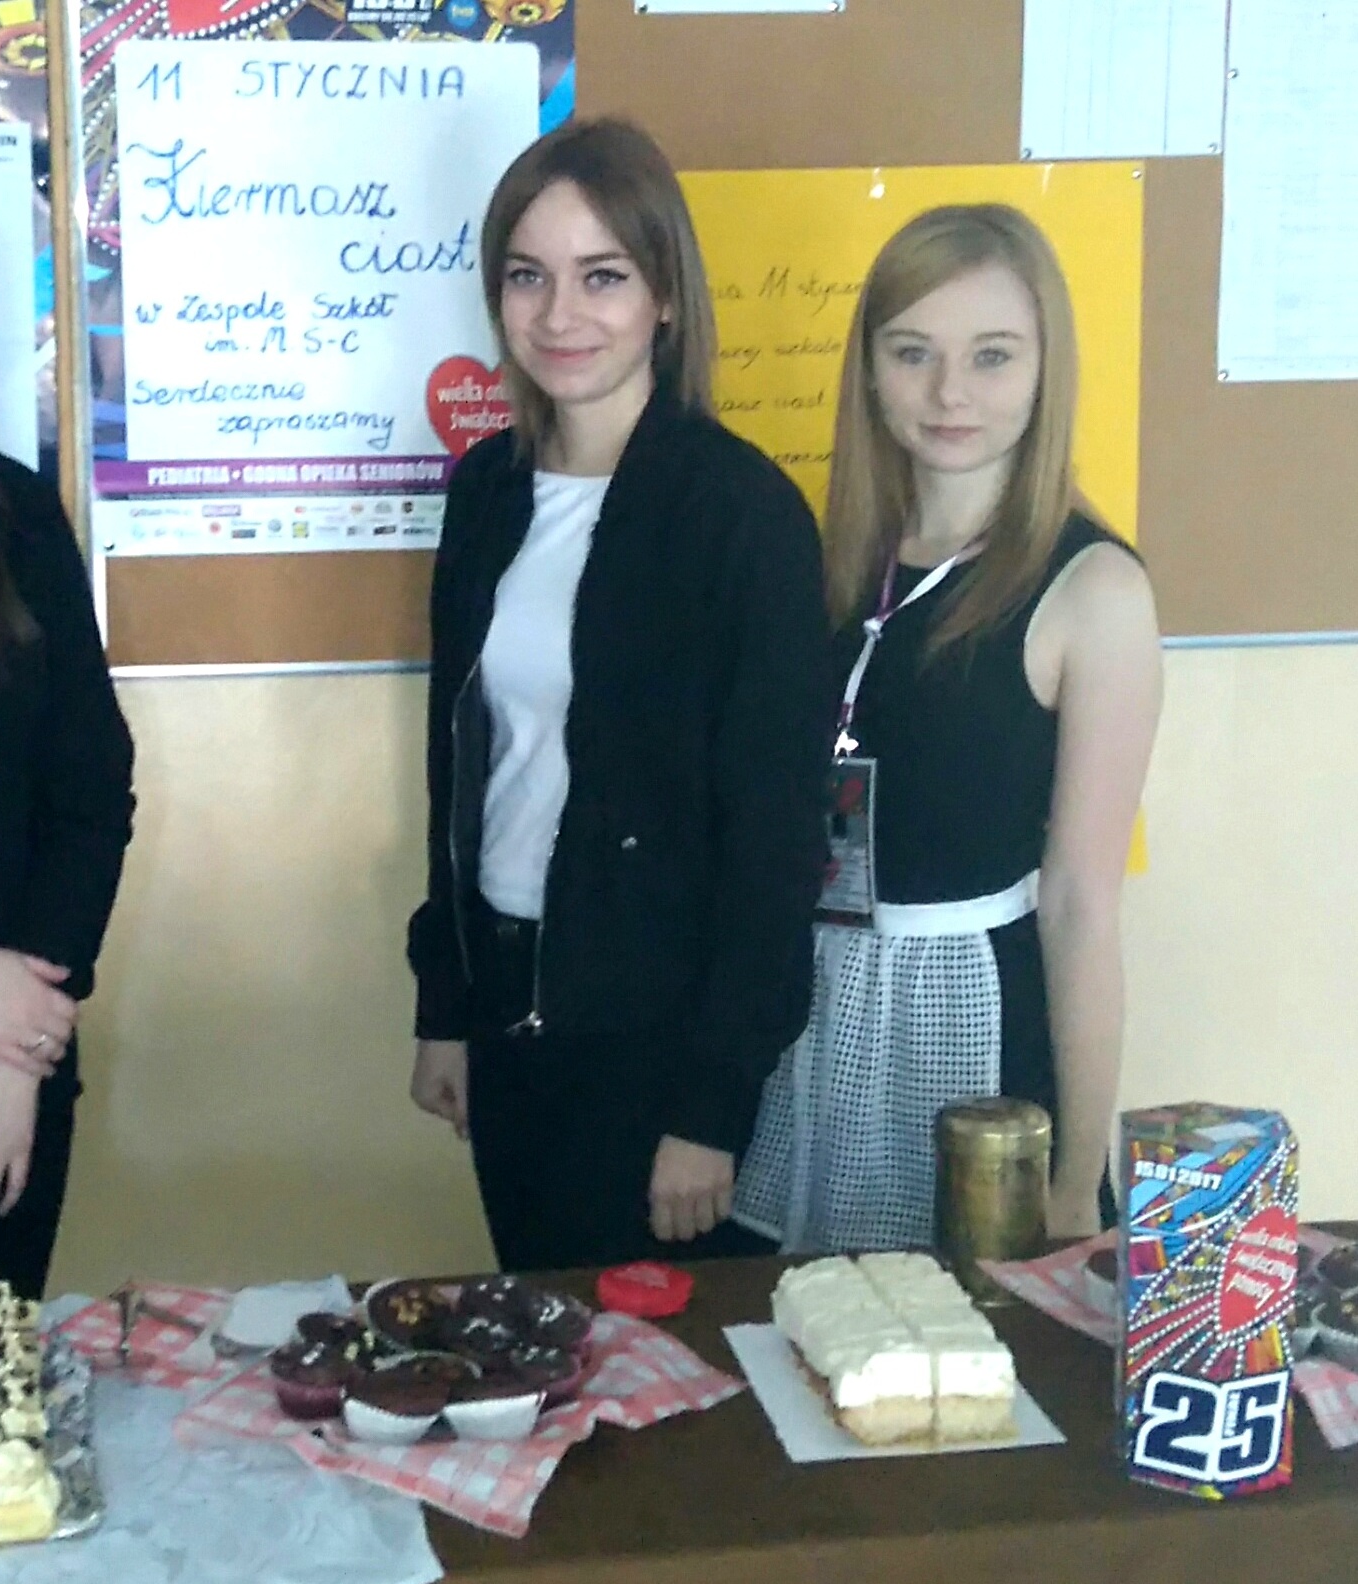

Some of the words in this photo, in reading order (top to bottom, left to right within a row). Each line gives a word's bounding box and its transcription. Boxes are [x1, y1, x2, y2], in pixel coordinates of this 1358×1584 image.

[136, 62, 183, 101] 11
[234, 60, 468, 101] STYCZNIA
[125, 138, 397, 225] Kiermasz
[340, 221, 476, 275] ciast
[135, 302, 163, 325] w
[176, 290, 287, 334] Zespole
[131, 378, 307, 407] Serdecznie
[217, 411, 396, 451] zapraszamy
[1134, 1370, 1289, 1482] 25
